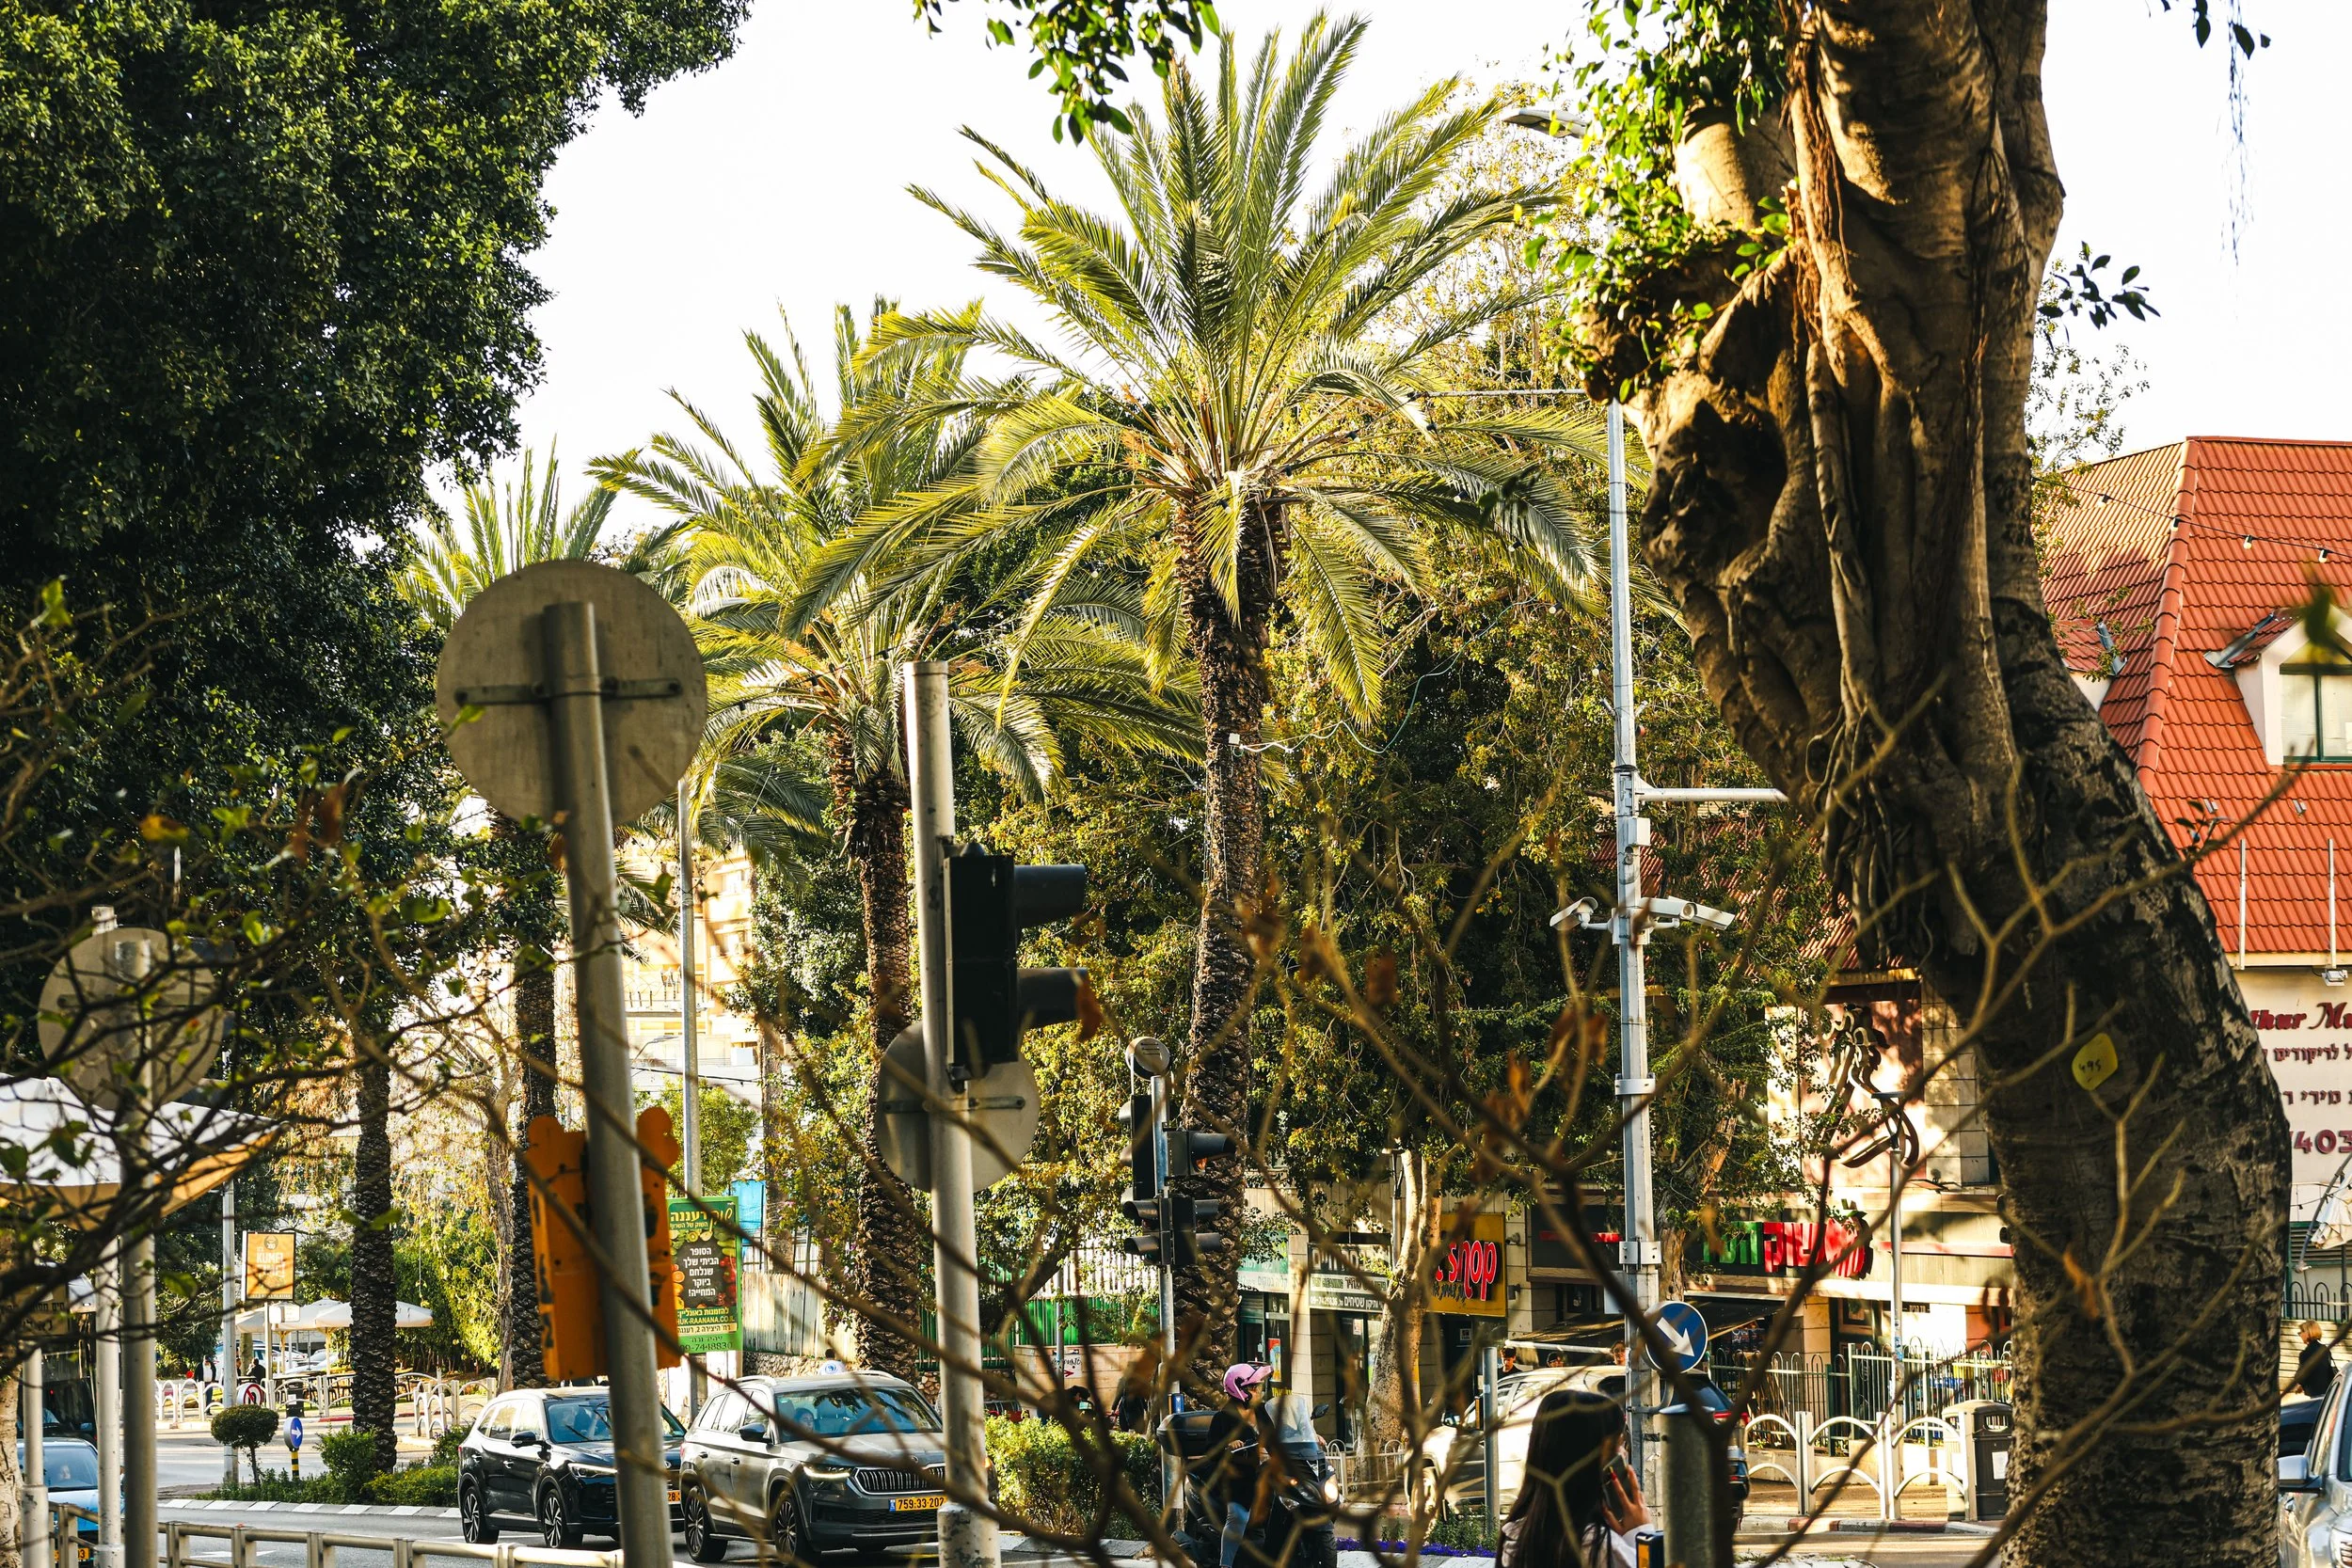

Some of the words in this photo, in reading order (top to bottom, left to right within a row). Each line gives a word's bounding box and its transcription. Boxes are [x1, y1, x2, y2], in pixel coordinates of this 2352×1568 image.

[2274, 1043, 2340, 1065] לריקודים
[2300, 1089, 2342, 1105] מירי
[2290, 1129, 2352, 1155] 403
[670, 1211, 708, 1222] רעננה
[683, 1258, 699, 1267] שלך
